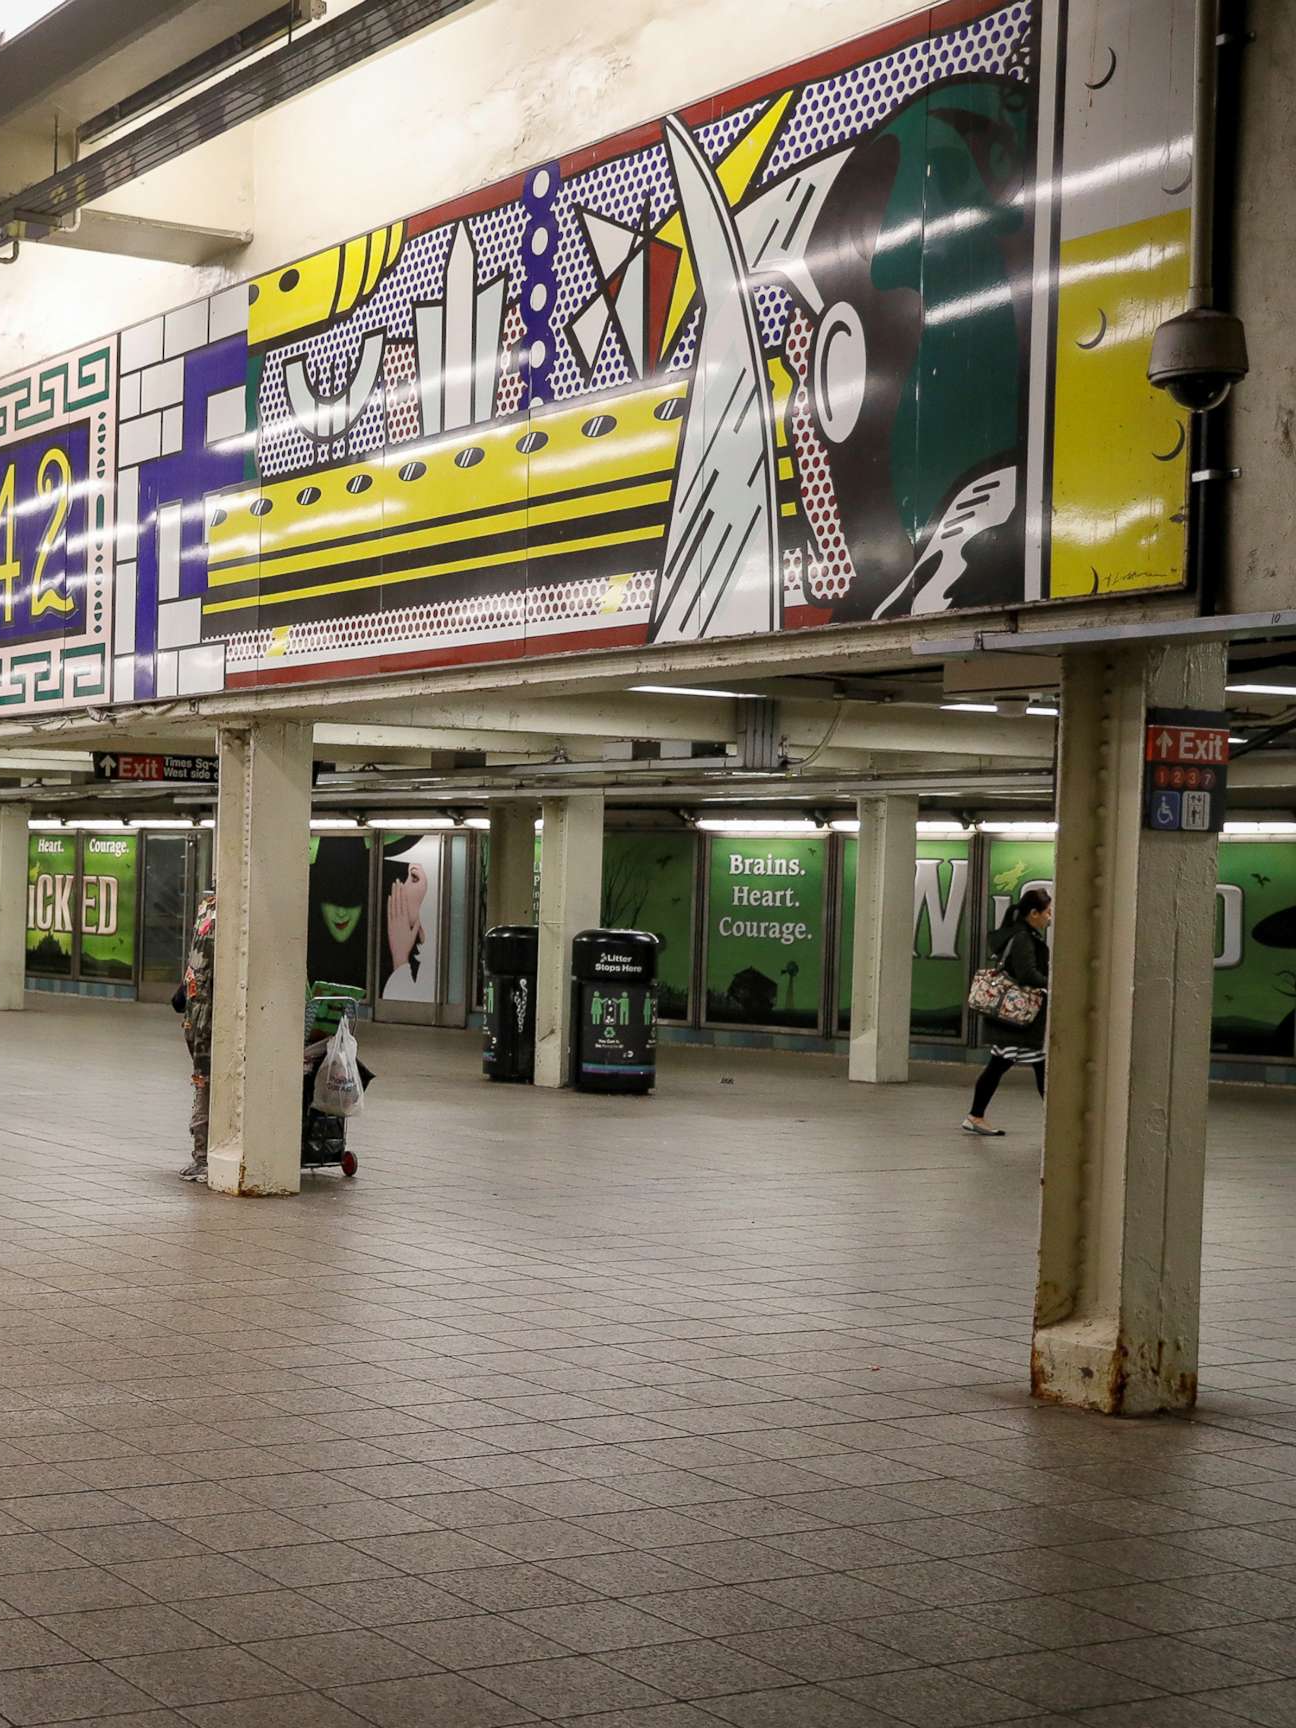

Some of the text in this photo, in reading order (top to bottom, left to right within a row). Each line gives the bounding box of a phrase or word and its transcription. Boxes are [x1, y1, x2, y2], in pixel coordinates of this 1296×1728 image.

[1178, 731, 1223, 760] Exit
[119, 756, 158, 779] Exit
[163, 756, 219, 772] Times Sq-4
[163, 767, 188, 778] West
[191, 768, 211, 780] side
[38, 838, 130, 857] Heart. Courage.
[729, 853, 806, 876] Brains.
[27, 874, 118, 935] ICKED
[732, 886, 800, 907] Heart.
[719, 916, 812, 945] Courage.
[595, 963, 642, 973] Stops Here
[607, 954, 633, 963] Litter
